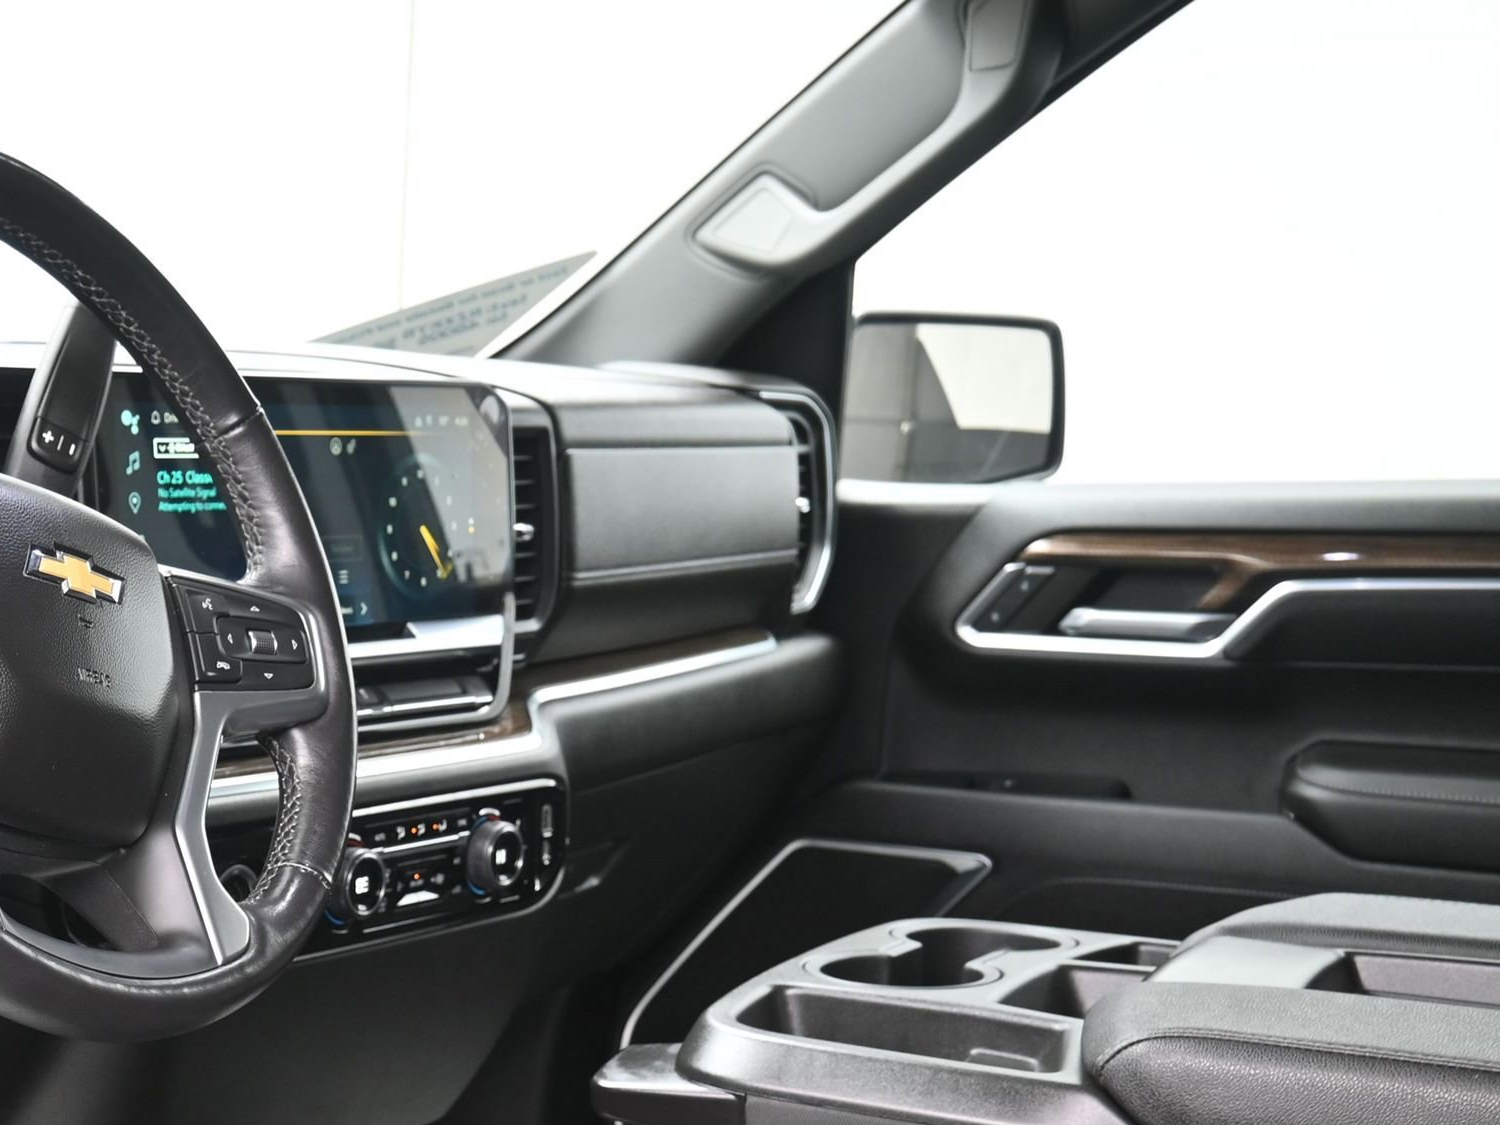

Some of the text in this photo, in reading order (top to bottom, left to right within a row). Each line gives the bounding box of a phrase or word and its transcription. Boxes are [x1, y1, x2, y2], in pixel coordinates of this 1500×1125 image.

[157, 470, 171, 485] Ch
[171, 470, 184, 485] 25
[158, 486, 217, 500] No Satellite Signal
